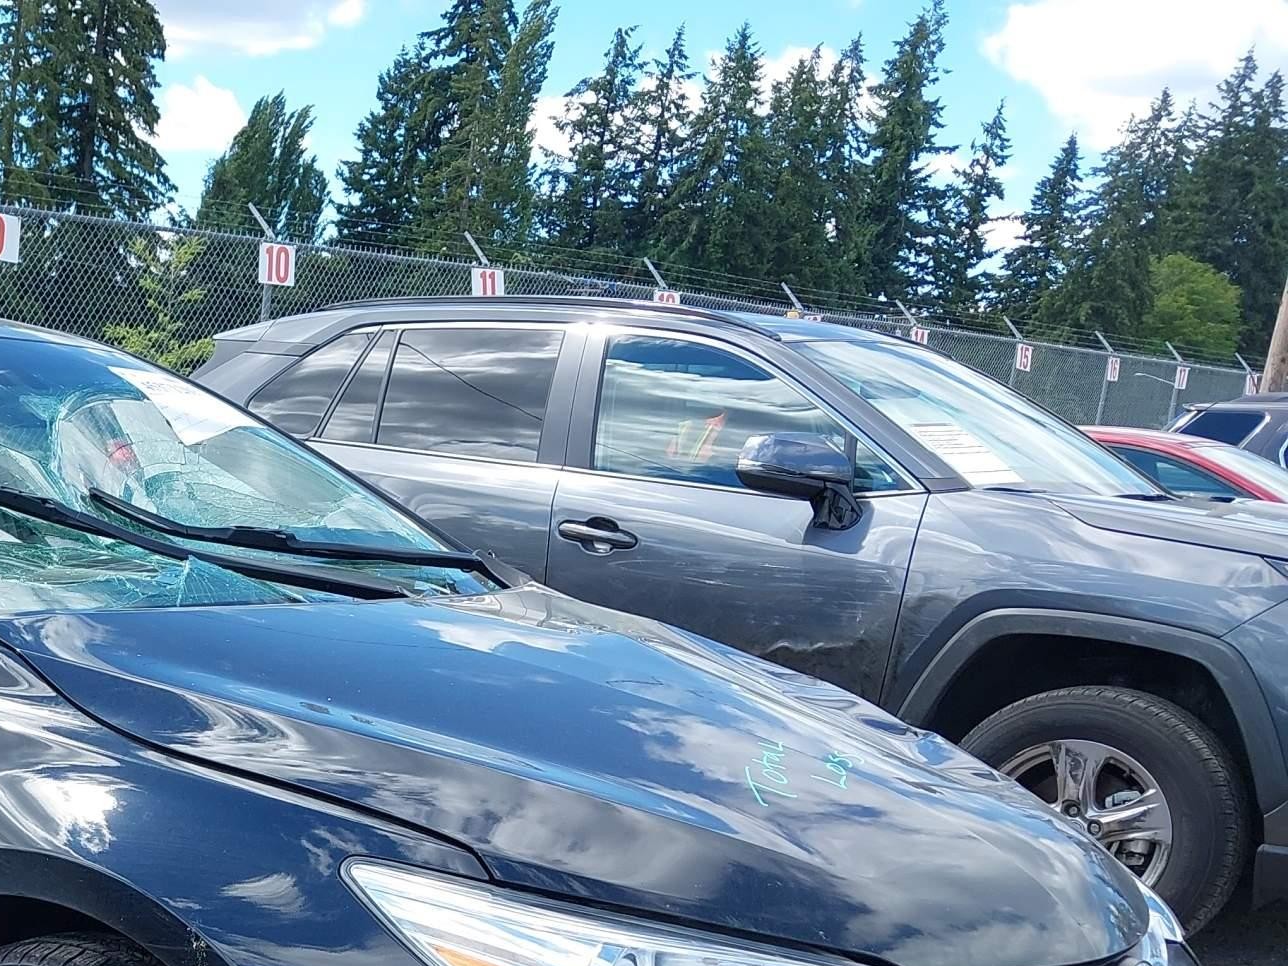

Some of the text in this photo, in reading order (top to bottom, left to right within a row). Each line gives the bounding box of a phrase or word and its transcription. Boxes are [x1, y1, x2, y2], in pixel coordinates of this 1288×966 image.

[265, 245, 290, 284] 10
[479, 270, 496, 296] 11
[1019, 345, 1030, 370] 15
[1109, 359, 1119, 380] 16
